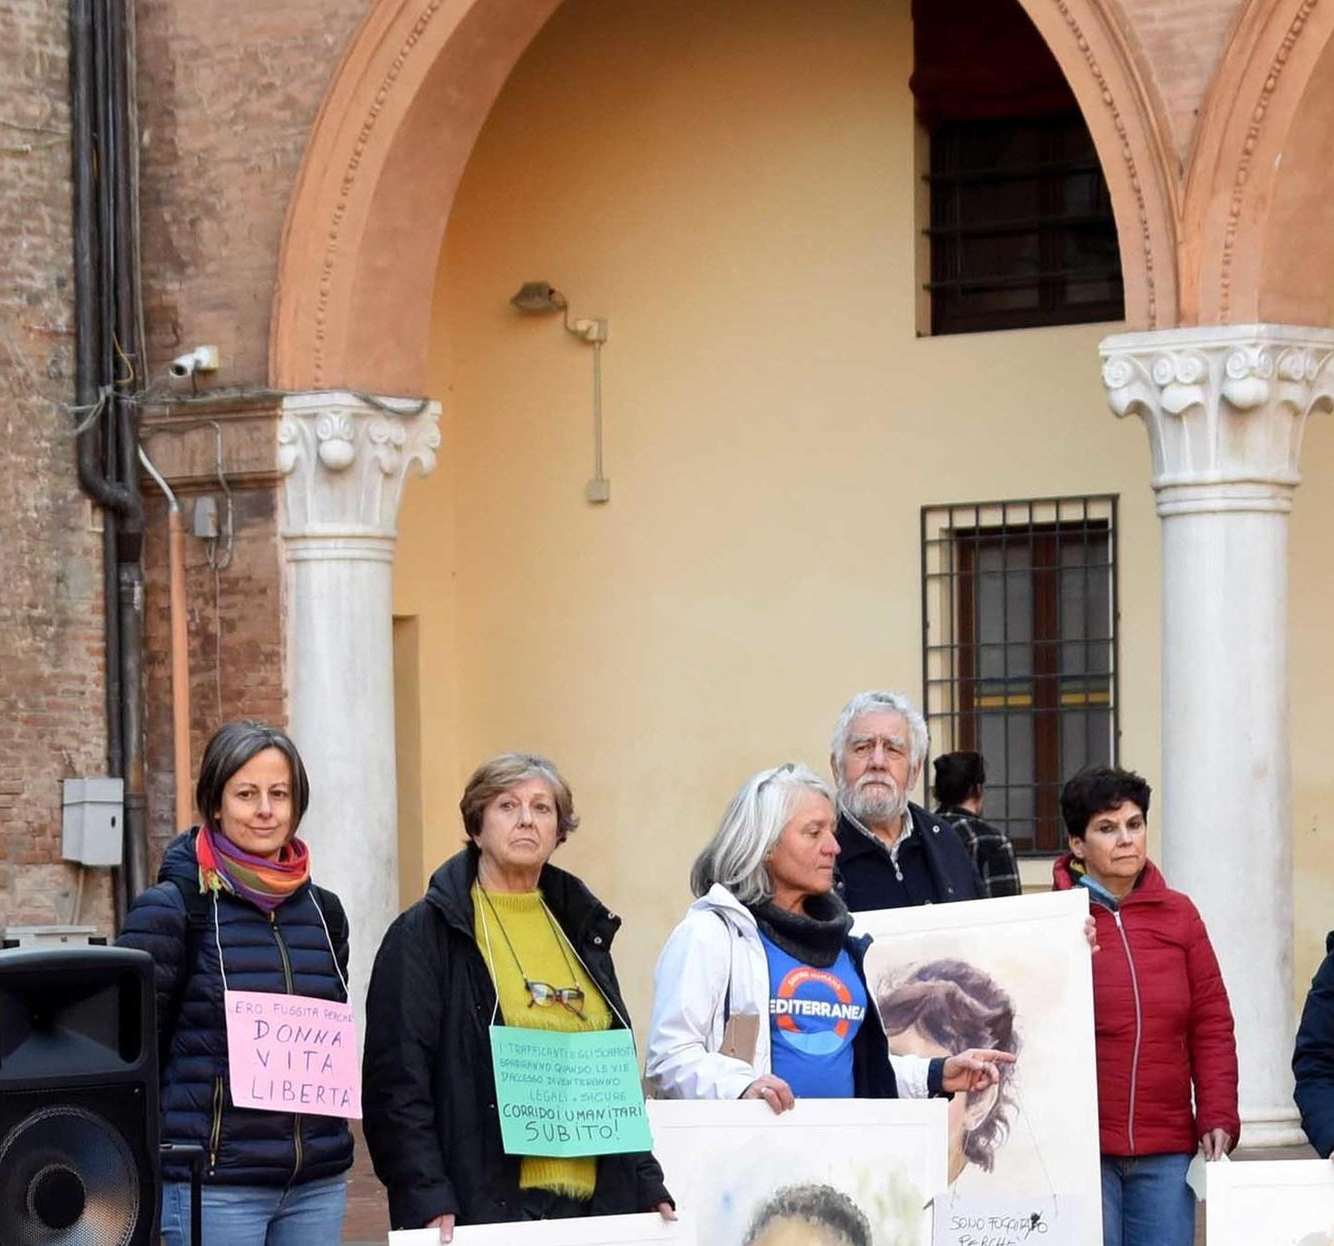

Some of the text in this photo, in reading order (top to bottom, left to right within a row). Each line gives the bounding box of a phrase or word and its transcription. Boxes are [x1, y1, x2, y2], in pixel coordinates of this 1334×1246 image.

[235, 1001, 264, 1014] ERO
[273, 1003, 318, 1019] FUGGITA
[770, 999, 866, 1020] EDITERRANEA
[254, 1019, 343, 1047] DONNA
[256, 1048, 333, 1075] VITA
[596, 1064, 608, 1074] LE
[612, 1063, 630, 1074] VIE
[949, 1215, 985, 1230] SONO
